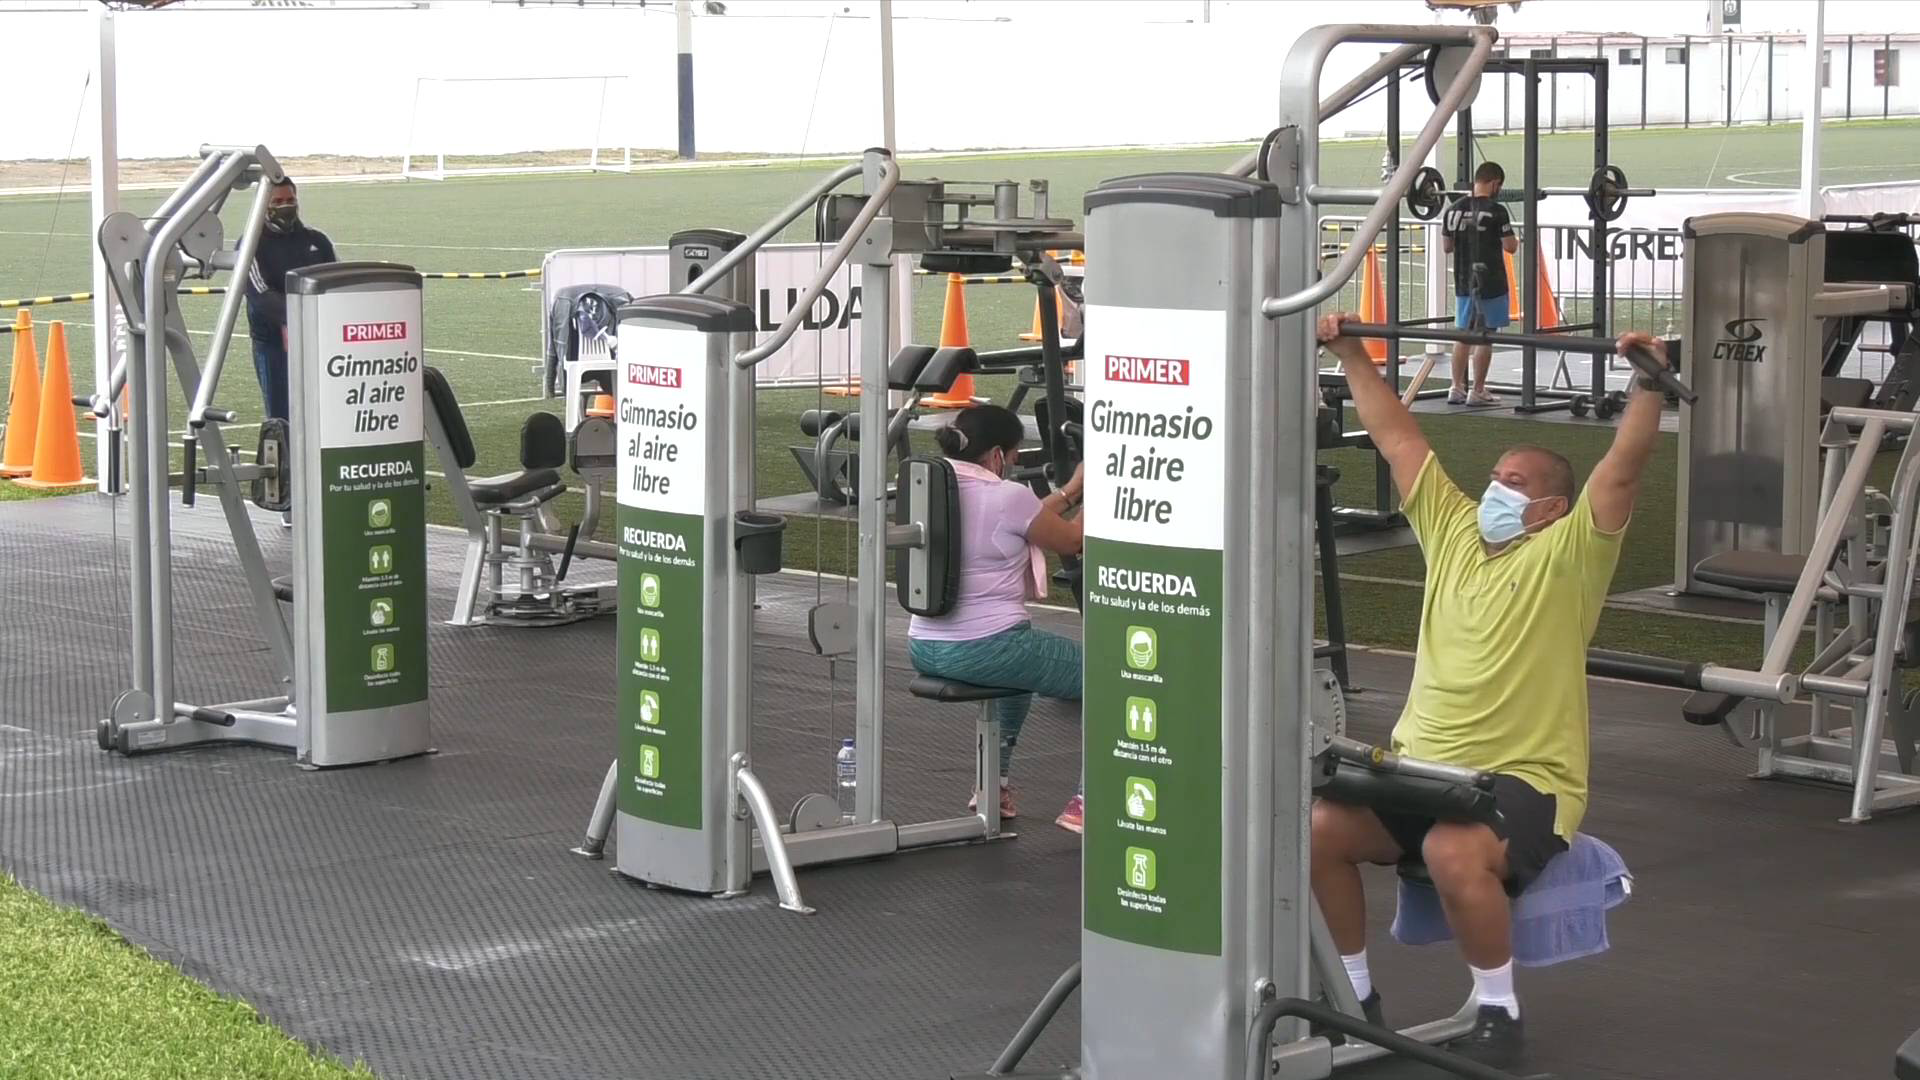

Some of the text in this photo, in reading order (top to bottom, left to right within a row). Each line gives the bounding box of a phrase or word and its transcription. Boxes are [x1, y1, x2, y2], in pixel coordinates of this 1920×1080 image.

[1447, 210, 1492, 231] UFC
[1554, 227, 1683, 260] INGRE
[346, 323, 403, 340] PRIMER
[327, 351, 418, 377] Gimnasio
[1712, 343, 1767, 362] CYBEX
[629, 364, 678, 387] PRIMER
[1108, 356, 1183, 383] PRIMER
[346, 380, 405, 405] al aire
[355, 409, 399, 433] libre
[620, 397, 697, 431] Gimnasio
[1091, 399, 1213, 440] Gimnasio
[628, 432, 678, 462] al aire
[340, 460, 413, 480] RECUERDA
[1105, 444, 1184, 482] al aire
[633, 465, 670, 495] libre
[1114, 486, 1172, 524] libre
[623, 526, 686, 552] RECUERDA
[662, 554, 672, 564] los
[673, 556, 695, 567] demás
[1098, 565, 1197, 597] RECUERDA
[1089, 591, 1211, 617] Por tu salud y la de los demás
